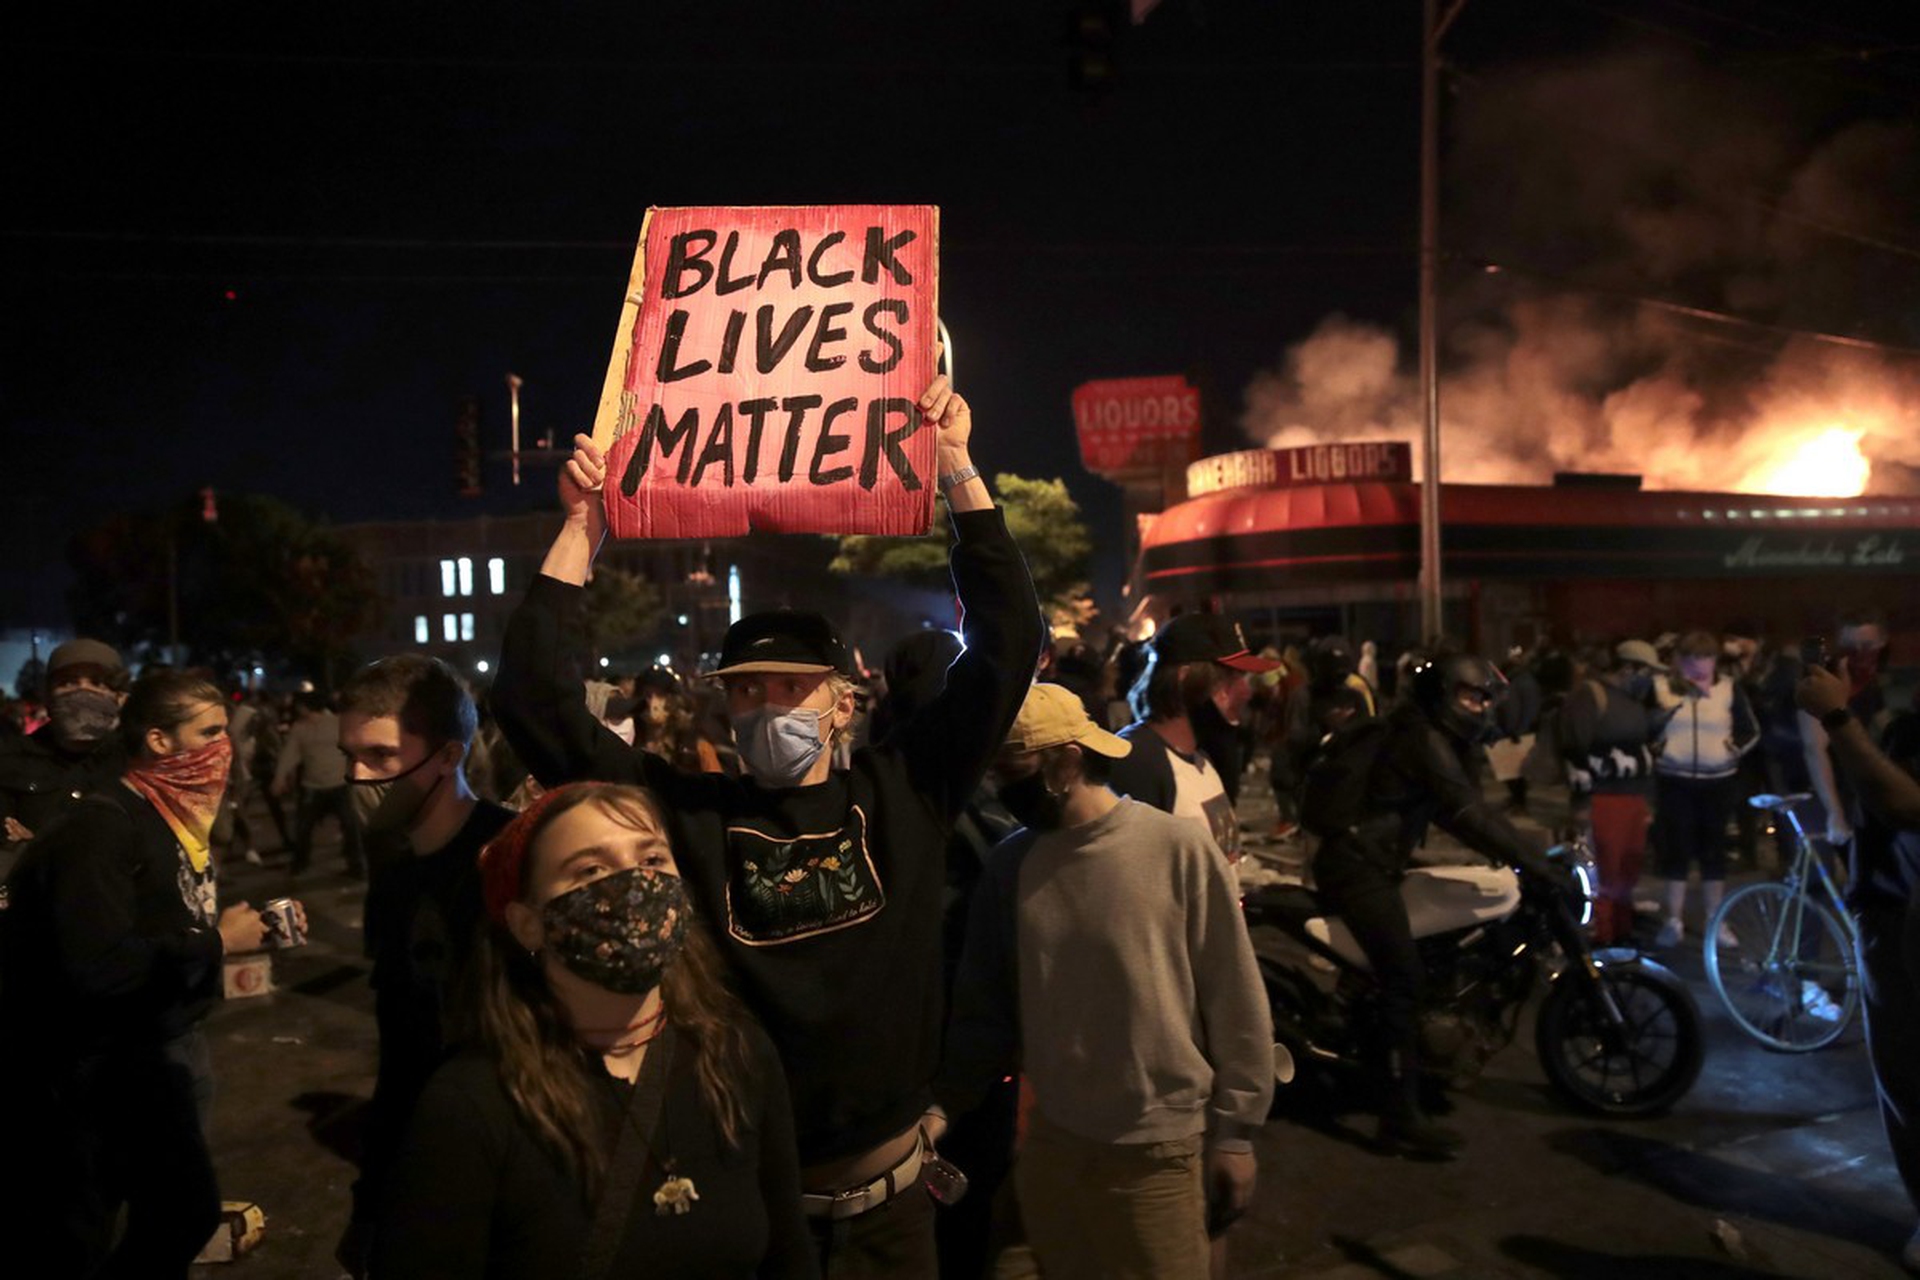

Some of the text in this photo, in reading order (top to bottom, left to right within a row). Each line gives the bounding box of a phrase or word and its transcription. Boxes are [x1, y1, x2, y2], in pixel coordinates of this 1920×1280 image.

[663, 227, 916, 298] BLACK
[657, 299, 909, 383] LIVES
[621, 395, 923, 497] MATTER
[1080, 393, 1198, 431] LIQUORS
[1290, 443, 1397, 480] LIQUORS
